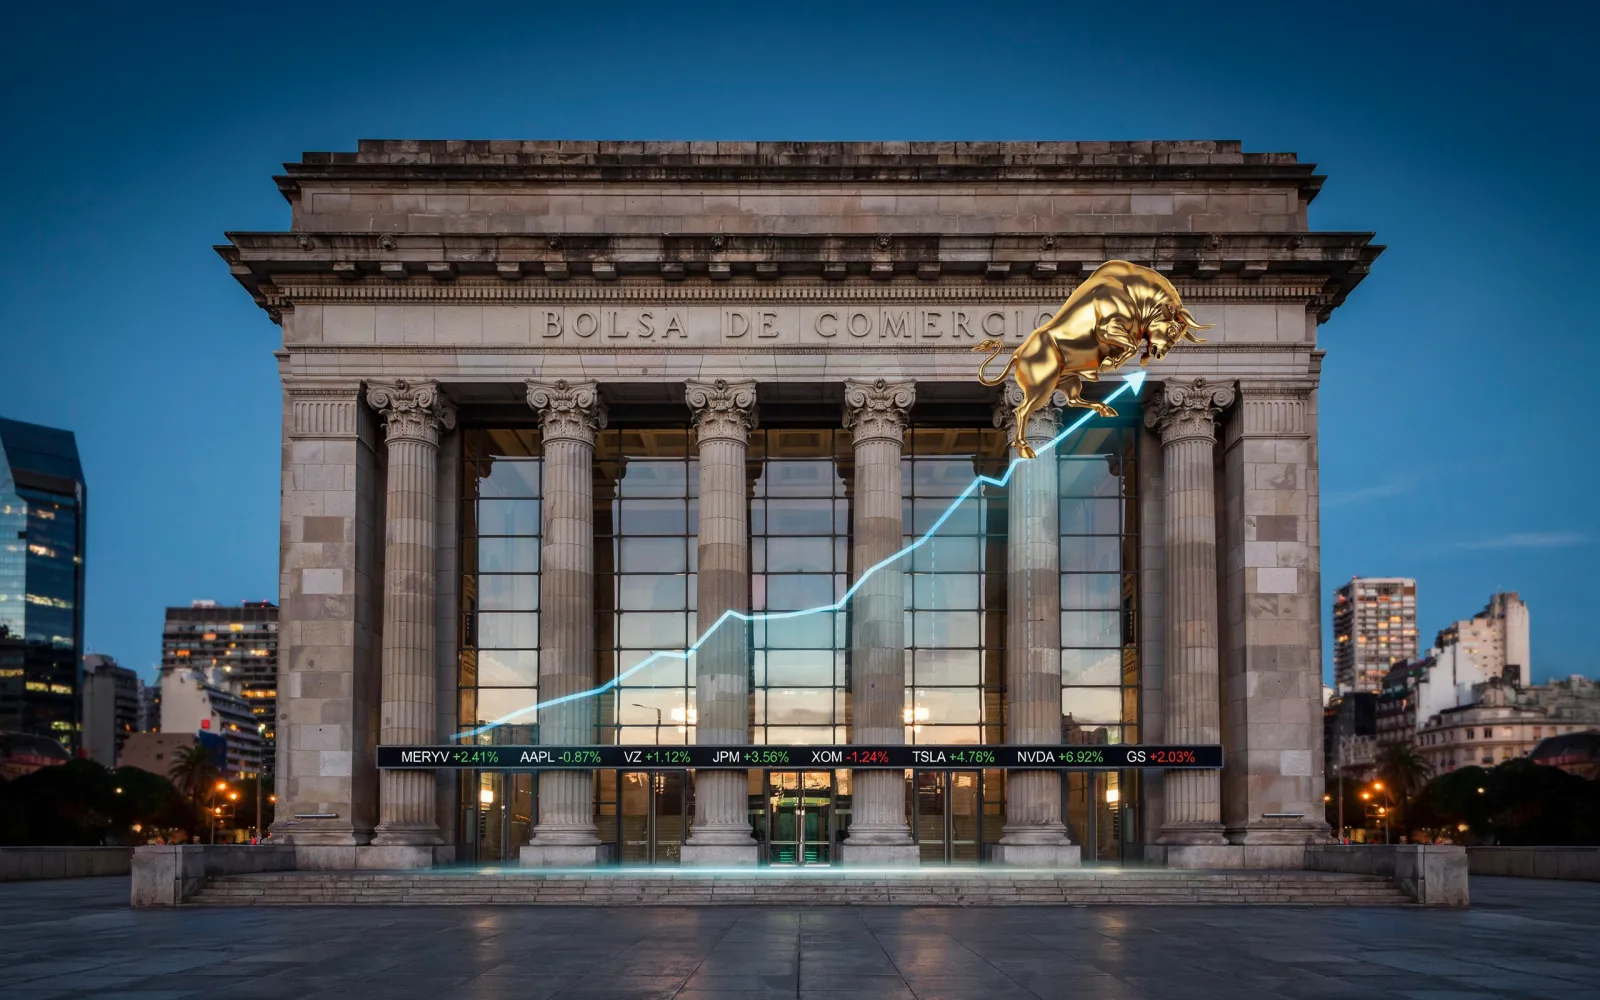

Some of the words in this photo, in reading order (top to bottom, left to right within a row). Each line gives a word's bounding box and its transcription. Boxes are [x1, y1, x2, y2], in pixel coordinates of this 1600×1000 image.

[541, 310, 688, 338] BOLSA
[725, 310, 779, 338] DE
[401, 750, 450, 763] MERYV
[452, 750, 499, 763] +2.41%
[519, 750, 556, 763] AAPL
[558, 750, 602, 763] -0.87%
[623, 750, 642, 763] VZ
[645, 750, 691, 763] +1.12%
[712, 750, 740, 763] JPM
[743, 750, 790, 763] +3.56%
[811, 750, 843, 763] XOM
[846, 750, 889, 763] -1.24%
[911, 750, 947, 763] TSLA
[949, 750, 995, 763] +4.78%
[1017, 750, 1056, 763] NVDA
[1058, 750, 1104, 763] +6.92%
[1126, 750, 1147, 763] GS
[1150, 750, 1196, 763] +2.03%
